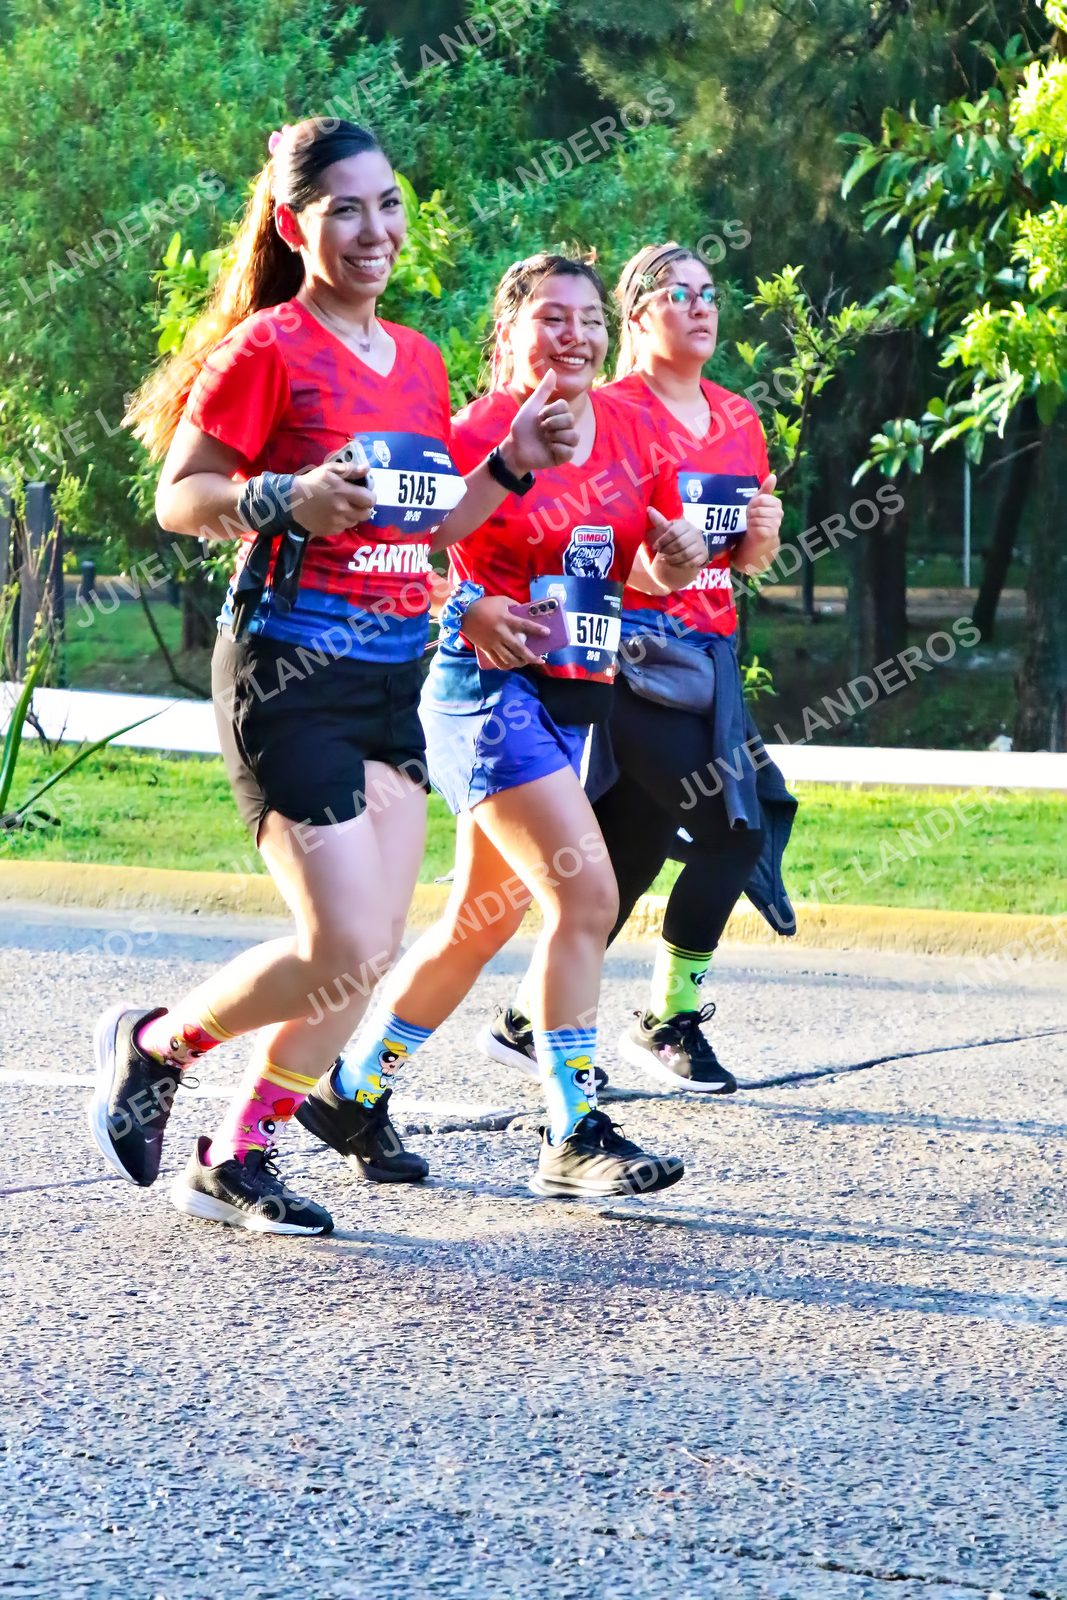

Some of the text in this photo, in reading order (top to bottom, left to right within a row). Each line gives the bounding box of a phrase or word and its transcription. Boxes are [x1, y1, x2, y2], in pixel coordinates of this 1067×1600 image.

[398, 473, 436, 506] 5145
[705, 507, 740, 531] 5146
[577, 533, 607, 542] BIMBO
[576, 615, 609, 646] 5147
